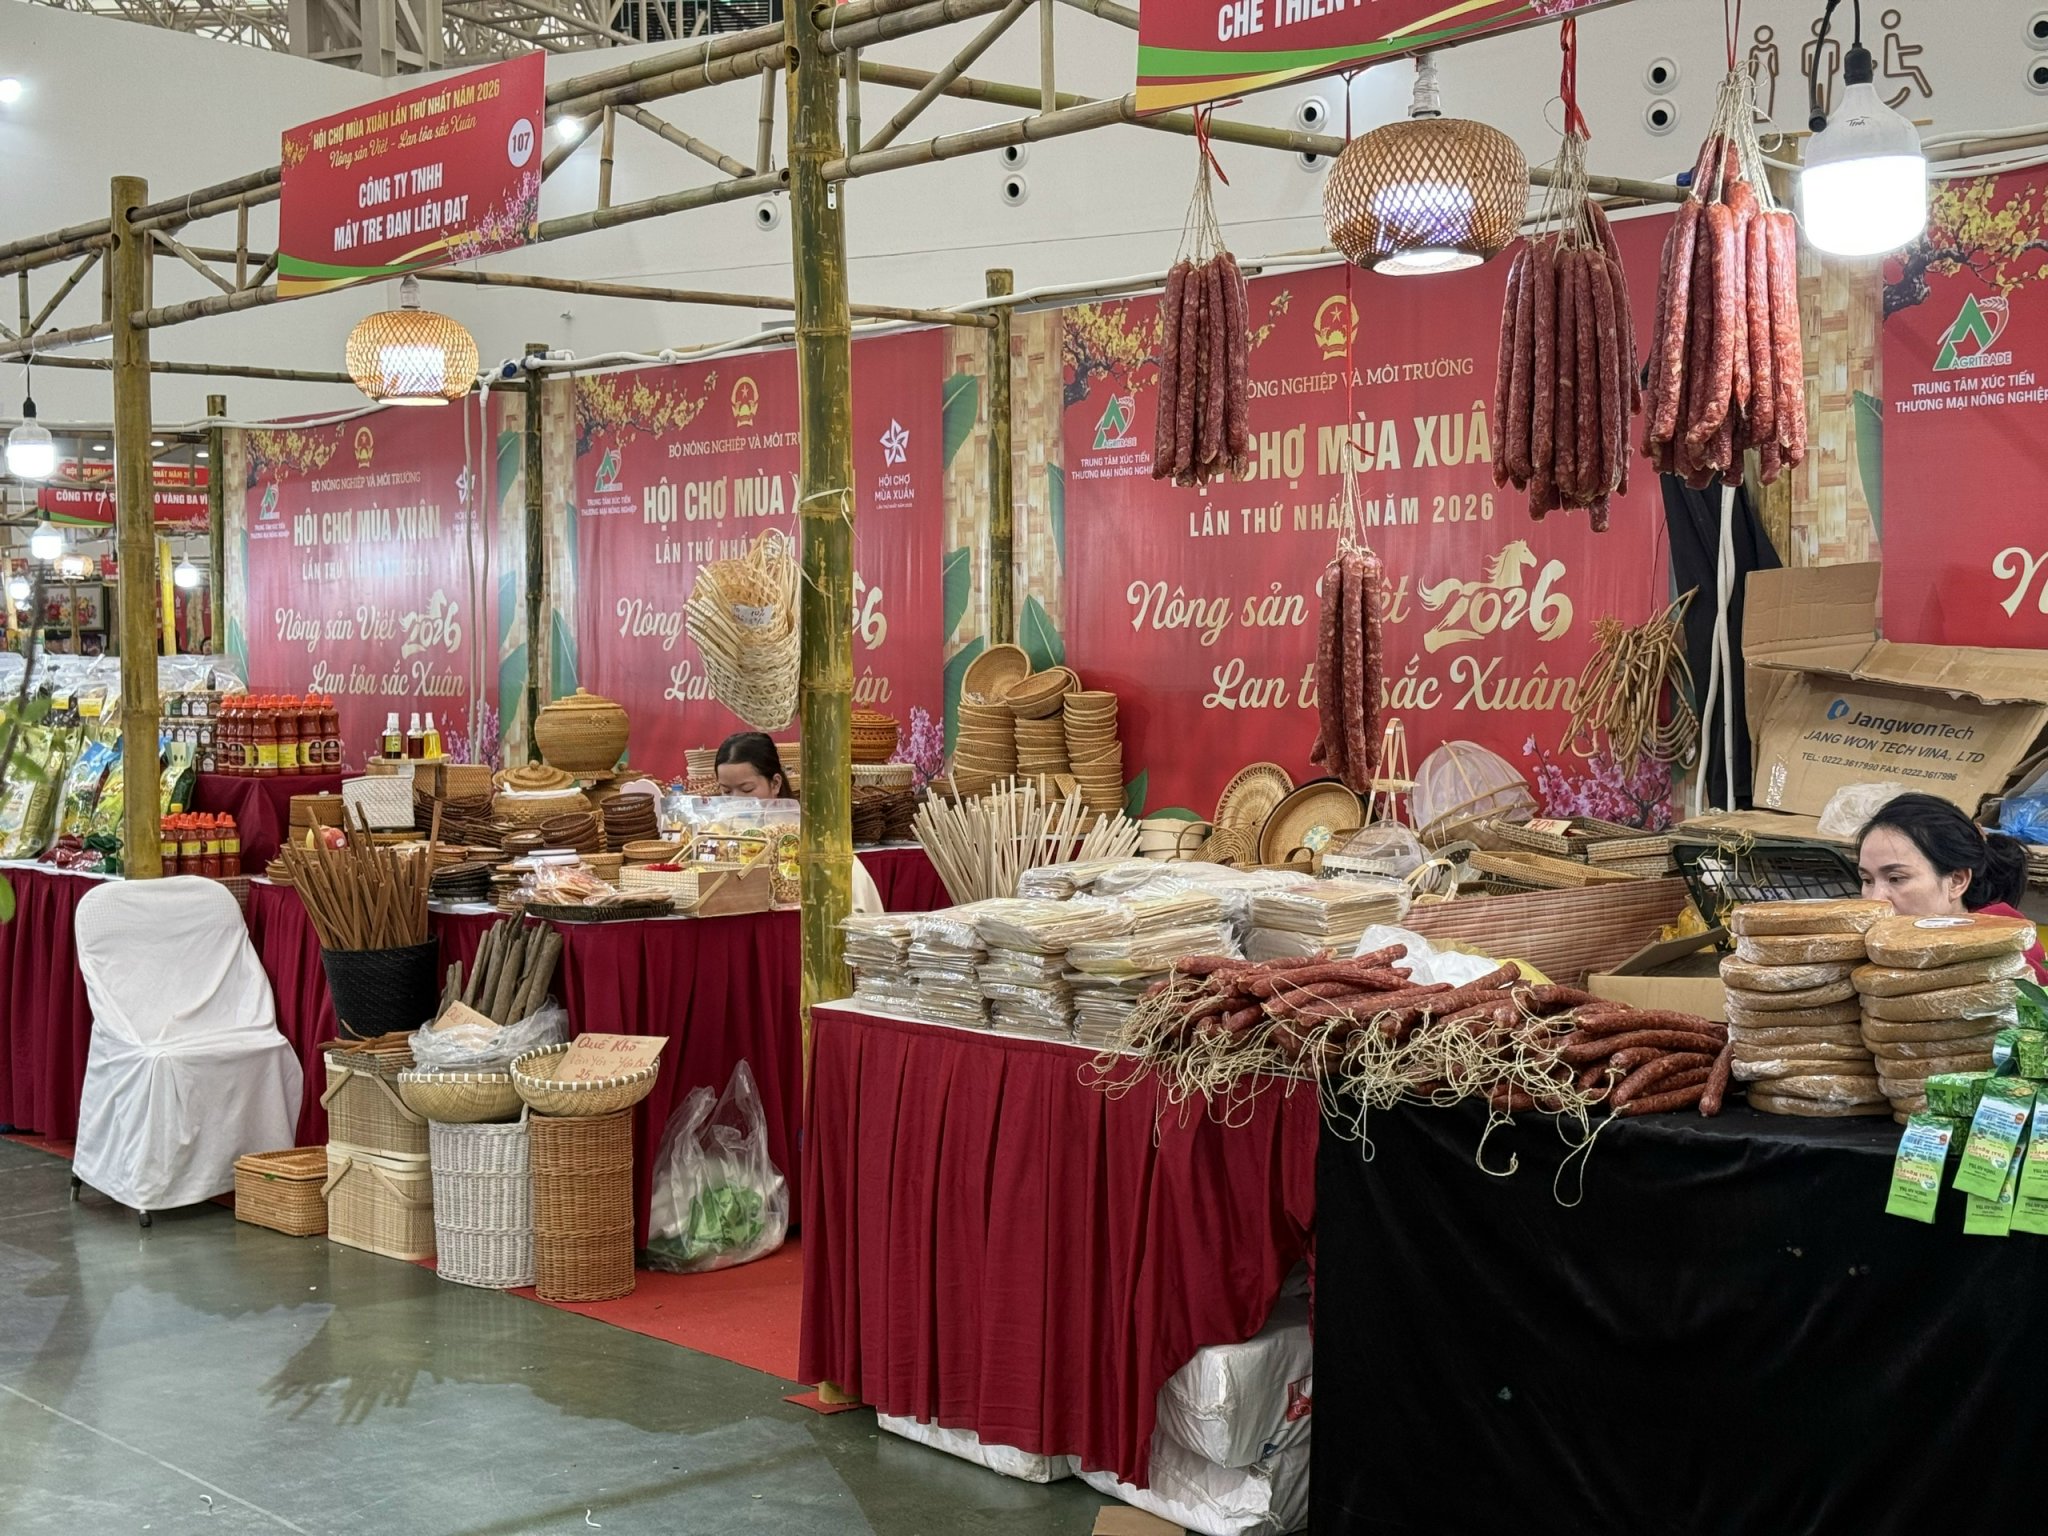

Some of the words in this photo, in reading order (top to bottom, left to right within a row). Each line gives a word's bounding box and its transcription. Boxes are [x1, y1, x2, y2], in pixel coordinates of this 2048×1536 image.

[313, 130, 327, 153] HỘI
[328, 122, 345, 147] CHỢ
[346, 116, 364, 141] MÙA
[365, 109, 389, 135] XUÂN
[391, 101, 407, 127] LẦN
[409, 98, 427, 121] THỨ
[427, 86, 451, 117] NHẤT
[453, 83, 475, 109] NĂM
[477, 78, 500, 102] 2026
[329, 150, 353, 171] Nông
[353, 144, 368, 162] sản
[368, 139, 389, 160] Việt
[397, 129, 418, 150] Lan
[451, 112, 478, 135] Xuân
[511, 131, 532, 154] 107
[358, 175, 391, 209] CÔNG
[393, 171, 410, 200] TY
[410, 162, 443, 197] TNHH
[333, 217, 361, 252] MÂY
[362, 216, 384, 242] TRE
[386, 212, 412, 240] ĐAN
[414, 204, 441, 234] LIÊN
[444, 194, 469, 234] ĐẠT
[1247, 377, 1278, 399] ÔNG
[1281, 371, 1338, 397] NGHIỆP
[1366, 363, 1400, 387] MÔI
[1403, 356, 1475, 380] TRƯỜNG
[1951, 351, 2012, 370] AGRITRADE
[1895, 398, 1944, 413] THƯƠNG
[1946, 395, 1968, 411] MẠI
[1970, 391, 2005, 408] NÔNG
[1911, 380, 1951, 396] TRUNG
[1953, 376, 1978, 392] TÂM
[1980, 373, 2006, 390] XÚC
[2007, 369, 2035, 387] TIẾN
[668, 441, 682, 459] BỘ
[682, 439, 711, 457] NÔNG
[711, 436, 746, 454] NGHIỆP
[747, 432, 762, 449] VÀ
[763, 430, 784, 449] MÔI
[1317, 410, 1401, 478] MÙA
[1412, 398, 1493, 469] XUÂ
[1080, 457, 1103, 468] TRUNG
[1104, 455, 1119, 466] TÂM
[1119, 452, 1134, 465] XÚC
[1113, 465, 1134, 477] NÔNG
[56, 489, 81, 502] CÔNG
[82, 491, 94, 502] TY
[162, 491, 185, 505] VÀNG
[186, 494, 199, 504] BA
[643, 475, 678, 532] HỘI
[684, 475, 728, 528] CHỢ
[733, 467, 785, 519] MÙA
[874, 488, 892, 502] MÙA
[892, 486, 915, 500] XUÂN
[878, 473, 893, 489] HỘI
[893, 472, 911, 488] CHỢ
[293, 506, 318, 554] HỘI
[322, 508, 352, 552] CHỢ
[356, 501, 392, 544] MÙA
[396, 498, 441, 544] XUÂN
[1189, 501, 1230, 537] LẦN
[1240, 500, 1284, 534] THỨ
[1365, 493, 1419, 527] NĂM
[1432, 492, 1495, 525] 2026
[655, 535, 681, 565] LẦN
[687, 536, 714, 563] THỨ
[720, 531, 757, 561] NHẤ
[275, 607, 322, 653] Nông
[324, 609, 355, 641] sản
[355, 605, 397, 648] Việt
[400, 590, 462, 659] 2026
[616, 597, 683, 652] Nông
[1126, 578, 1232, 648] Nông
[1239, 579, 1309, 629] sản
[1417, 559, 1574, 654] 2026
[307, 659, 347, 696] Lan
[349, 663, 378, 696] tỏa
[380, 658, 411, 697] sắc
[411, 660, 466, 698] Xuân
[664, 659, 716, 702] Lan
[1201, 657, 1290, 712] Lan
[1449, 655, 1580, 712] Xuân
[1848, 711, 1974, 740] JangwonTech
[1803, 730, 1841, 745] JANG
[1844, 735, 1878, 752] WON
[1879, 741, 1917, 756] TECH
[1956, 751, 1985, 764] LTD
